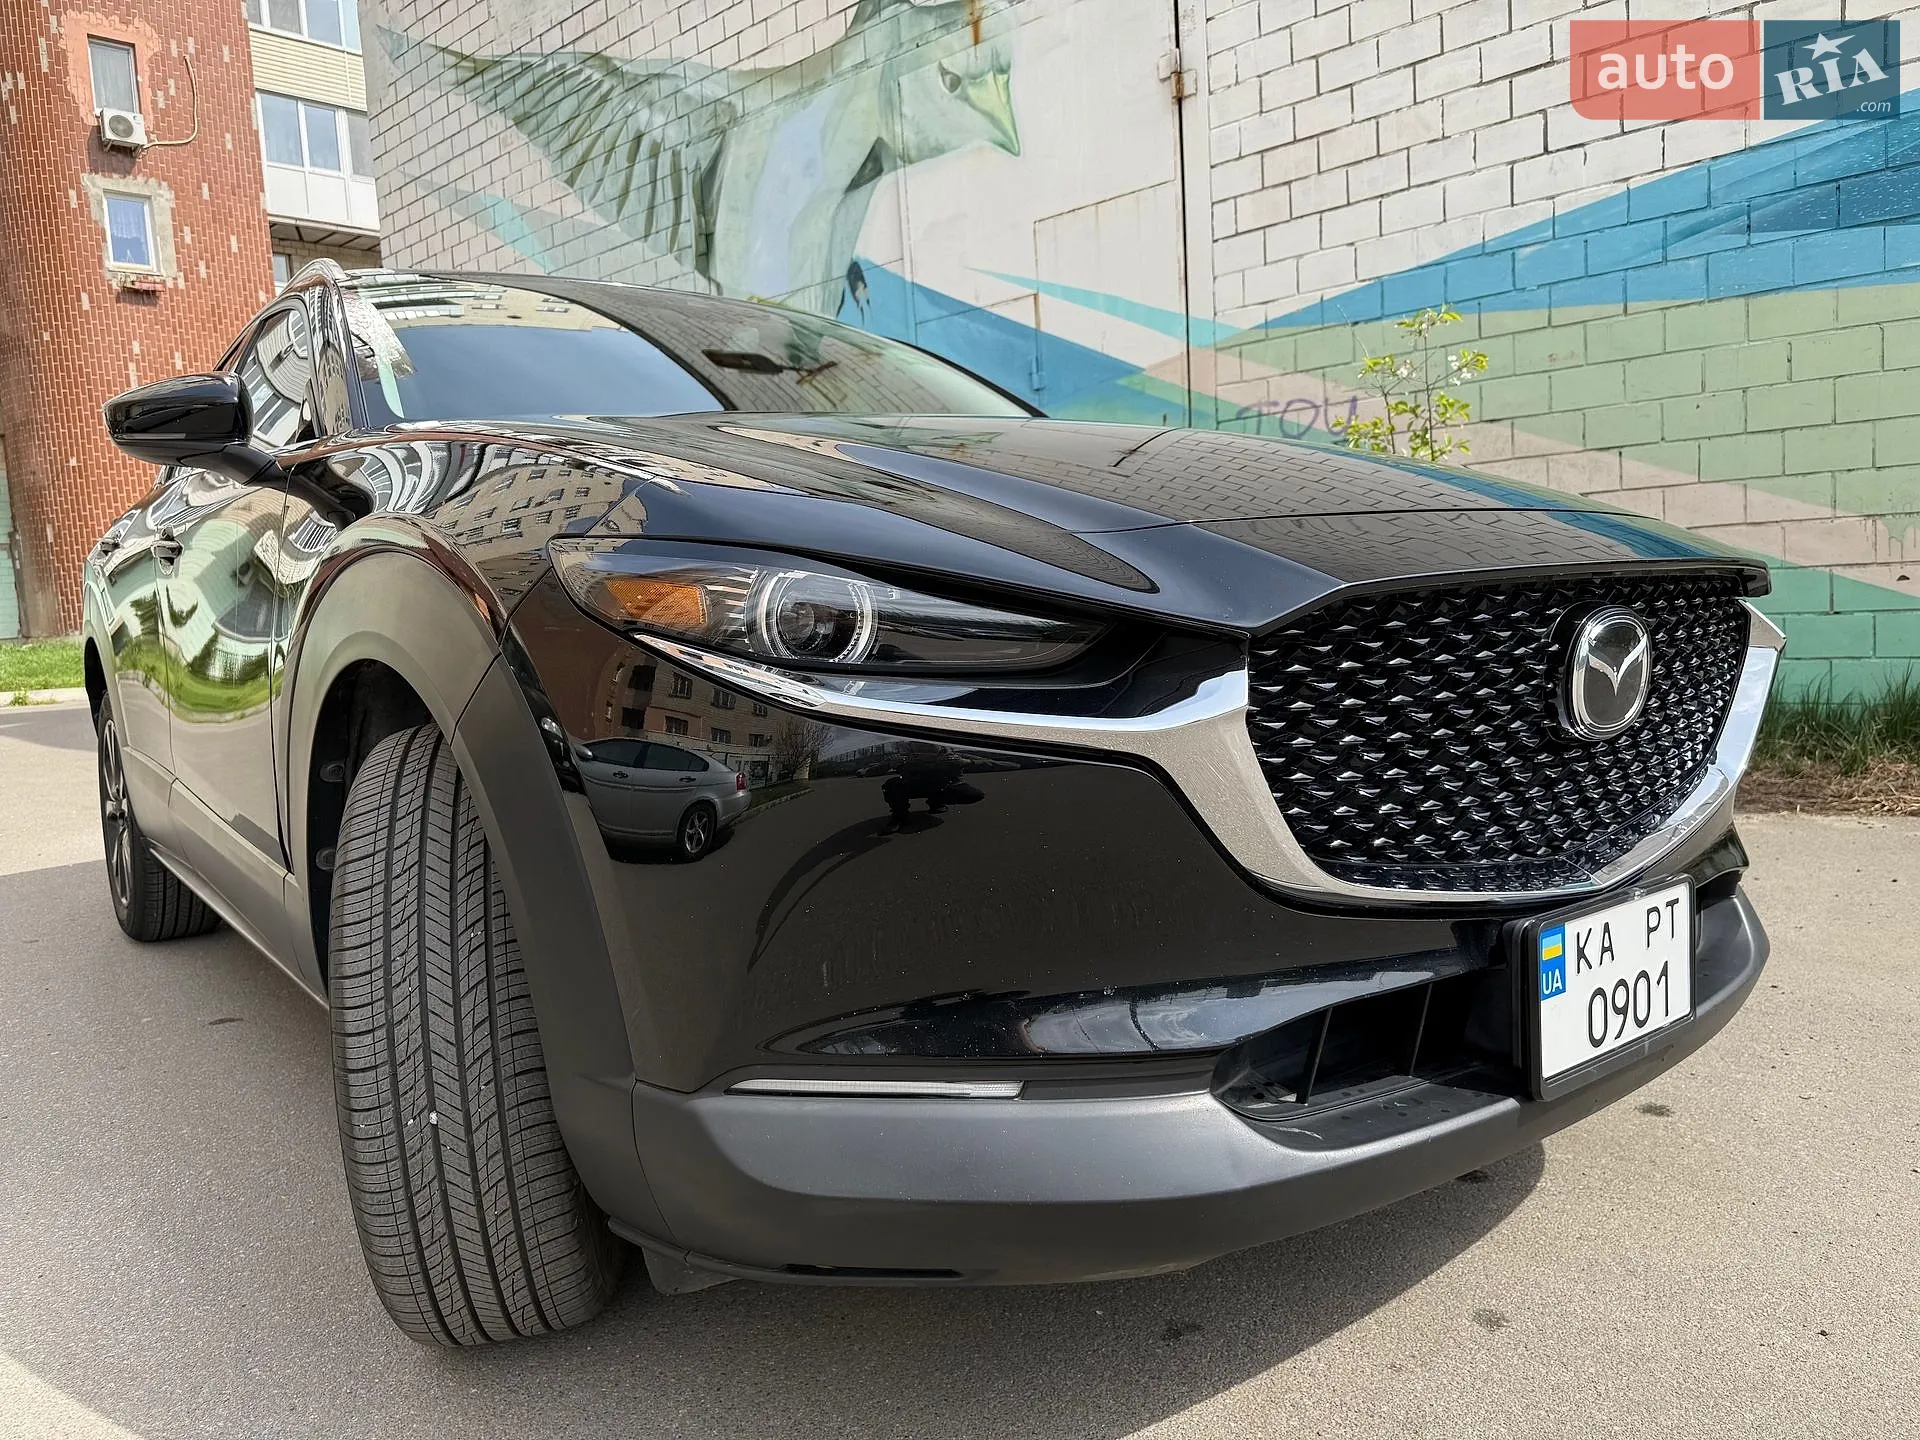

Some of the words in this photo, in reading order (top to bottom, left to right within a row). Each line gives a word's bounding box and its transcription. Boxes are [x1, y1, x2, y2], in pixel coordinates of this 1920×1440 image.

[1576, 921, 1615, 974] KA
[1646, 898, 1680, 948] PT
[1543, 968, 1562, 995] UA
[1588, 960, 1668, 1048] 0901
